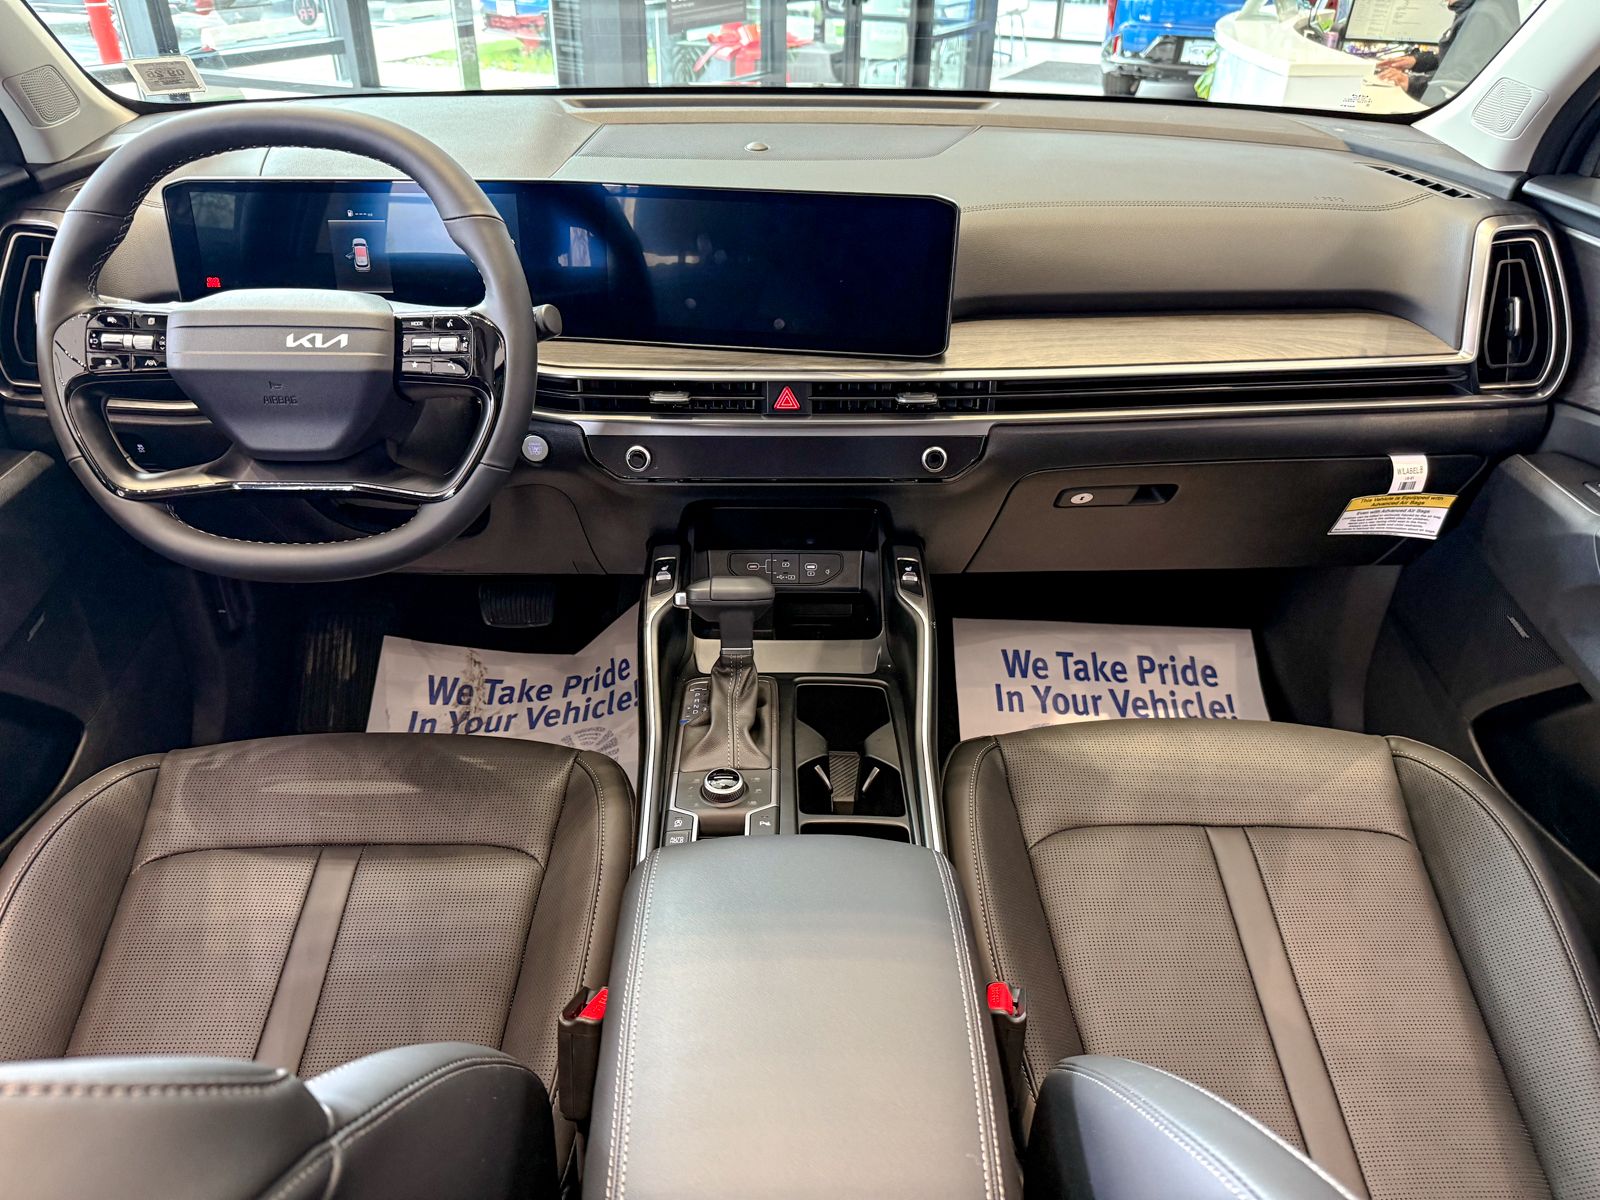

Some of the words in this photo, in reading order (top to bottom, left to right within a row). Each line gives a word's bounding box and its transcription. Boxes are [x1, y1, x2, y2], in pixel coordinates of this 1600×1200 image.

[286, 333, 349, 348] KIA
[263, 395, 298, 404] AIRBAG
[428, 675, 474, 706] We
[484, 678, 552, 706] Take
[562, 658, 630, 698] Pride
[1001, 649, 1049, 680] We
[1056, 651, 1128, 683] Take
[1137, 655, 1219, 688] Pride
[408, 711, 437, 734] In
[450, 711, 517, 735] Your
[527, 680, 638, 730] Vehicle!
[995, 683, 1024, 712] In
[1032, 685, 1102, 717] Your
[1109, 689, 1238, 720] Vehicle!
